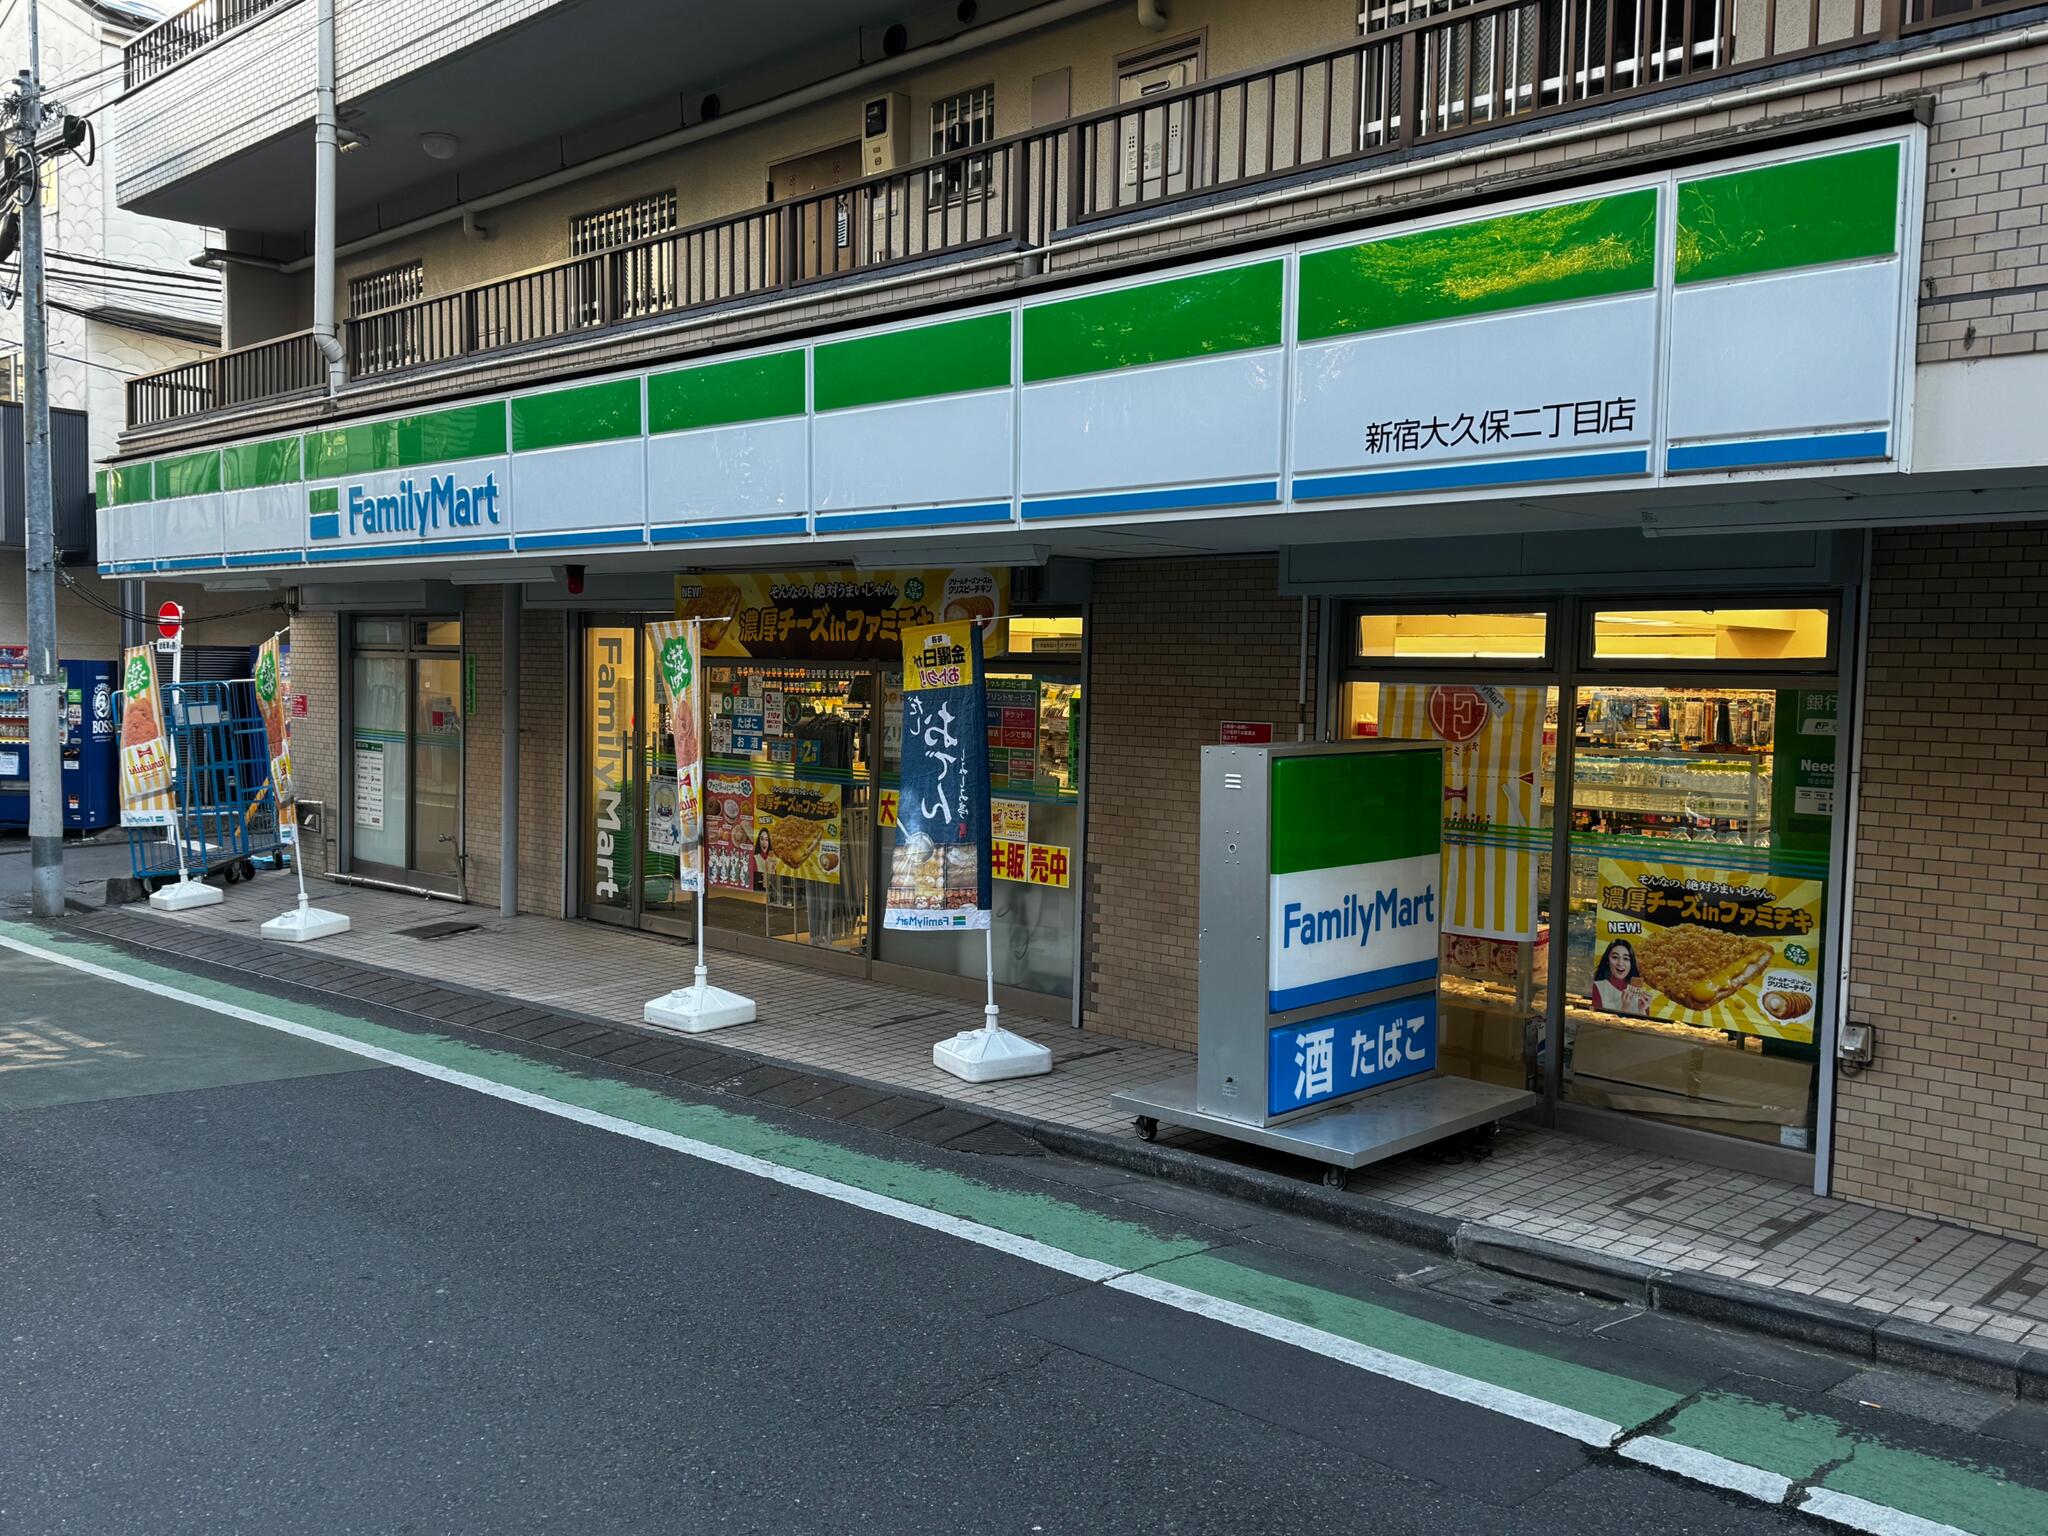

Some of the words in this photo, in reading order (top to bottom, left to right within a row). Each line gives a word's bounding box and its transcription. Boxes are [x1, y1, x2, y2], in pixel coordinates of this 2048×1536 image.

[1365, 396, 1637, 455] 新宿大久保二丁目店
[348, 471, 501, 537] FamilyMart
[92, 720, 114, 734] BOSS
[737, 718, 758, 729] たばこ
[593, 637, 622, 899] FamilyMart
[880, 792, 897, 825] 大
[1602, 885, 1814, 935] 濃厚チーズinファミチキ
[1638, 873, 1777, 901] そんなの、絶対うまいじゃん。
[1283, 883, 1435, 949] FamilyMart
[1608, 921, 1642, 934] NEW!
[1294, 1027, 1335, 1101] 酒
[1351, 1017, 1427, 1078] たばこ
